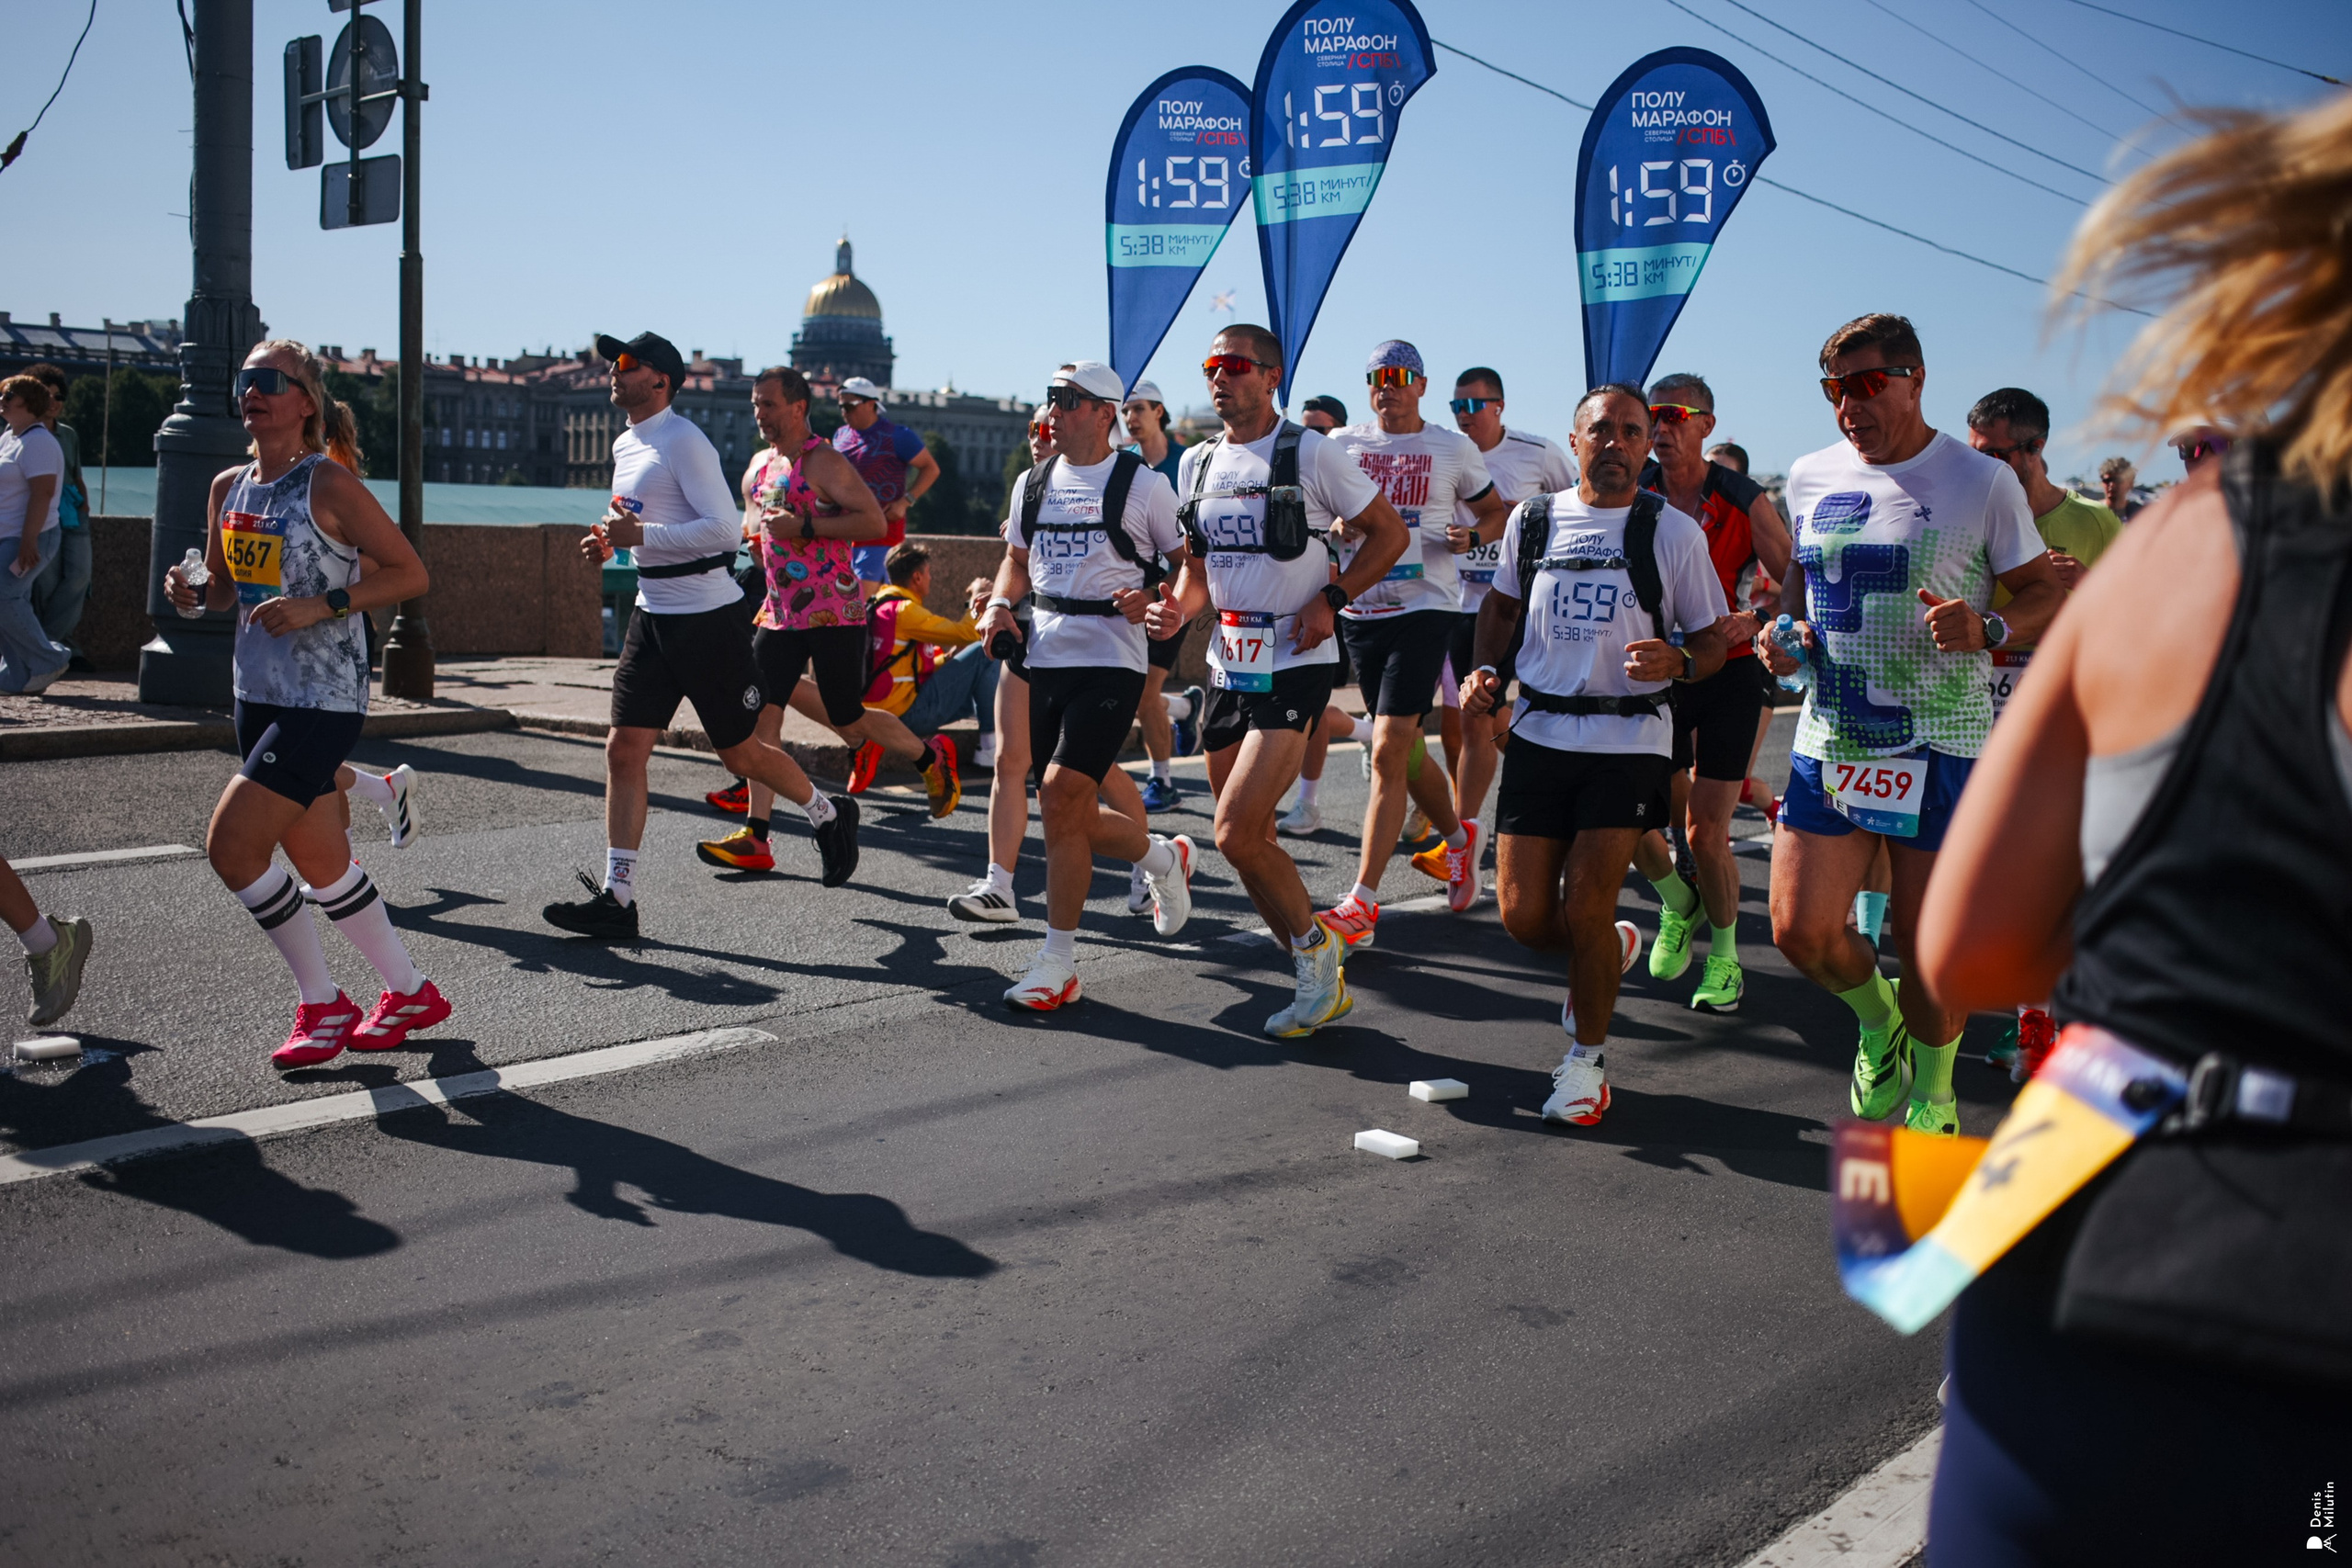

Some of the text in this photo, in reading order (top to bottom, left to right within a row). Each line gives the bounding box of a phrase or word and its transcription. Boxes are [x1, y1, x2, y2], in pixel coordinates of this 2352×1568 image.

[1304, 17, 1355, 35] ПОЛУ
[1305, 35, 1397, 54] МАРАФОН
[1159, 100, 1204, 116] ПОЛУ
[1632, 91, 1686, 108] ПОЛУ
[1159, 116, 1242, 130] МАРАФОН
[1284, 83, 1384, 149] 1:59
[1632, 109, 1732, 128] МАРАФОН
[1137, 156, 1229, 209] 1:59
[1273, 181, 1316, 209] 5:38
[1321, 191, 1341, 203] КМ
[1609, 159, 1713, 227] 1:59
[1120, 234, 1164, 256] 5:38
[1169, 245, 1186, 255] КМ
[1592, 261, 1638, 289] 5:38
[1644, 271, 1664, 285] КМ
[1213, 470, 1239, 480] ПОЛУ
[1047, 497, 1099, 505] МАРАФОН
[1569, 534, 1605, 544] ПОЛУ
[227, 537, 272, 569] 4567
[1566, 545, 1623, 558] МАРАФО
[1211, 555, 1233, 568] 5:38
[1553, 581, 1619, 623] 1:59
[1553, 626, 1580, 641] 5:38
[1220, 636, 1263, 662] 7617
[1837, 764, 1913, 800] 7459
